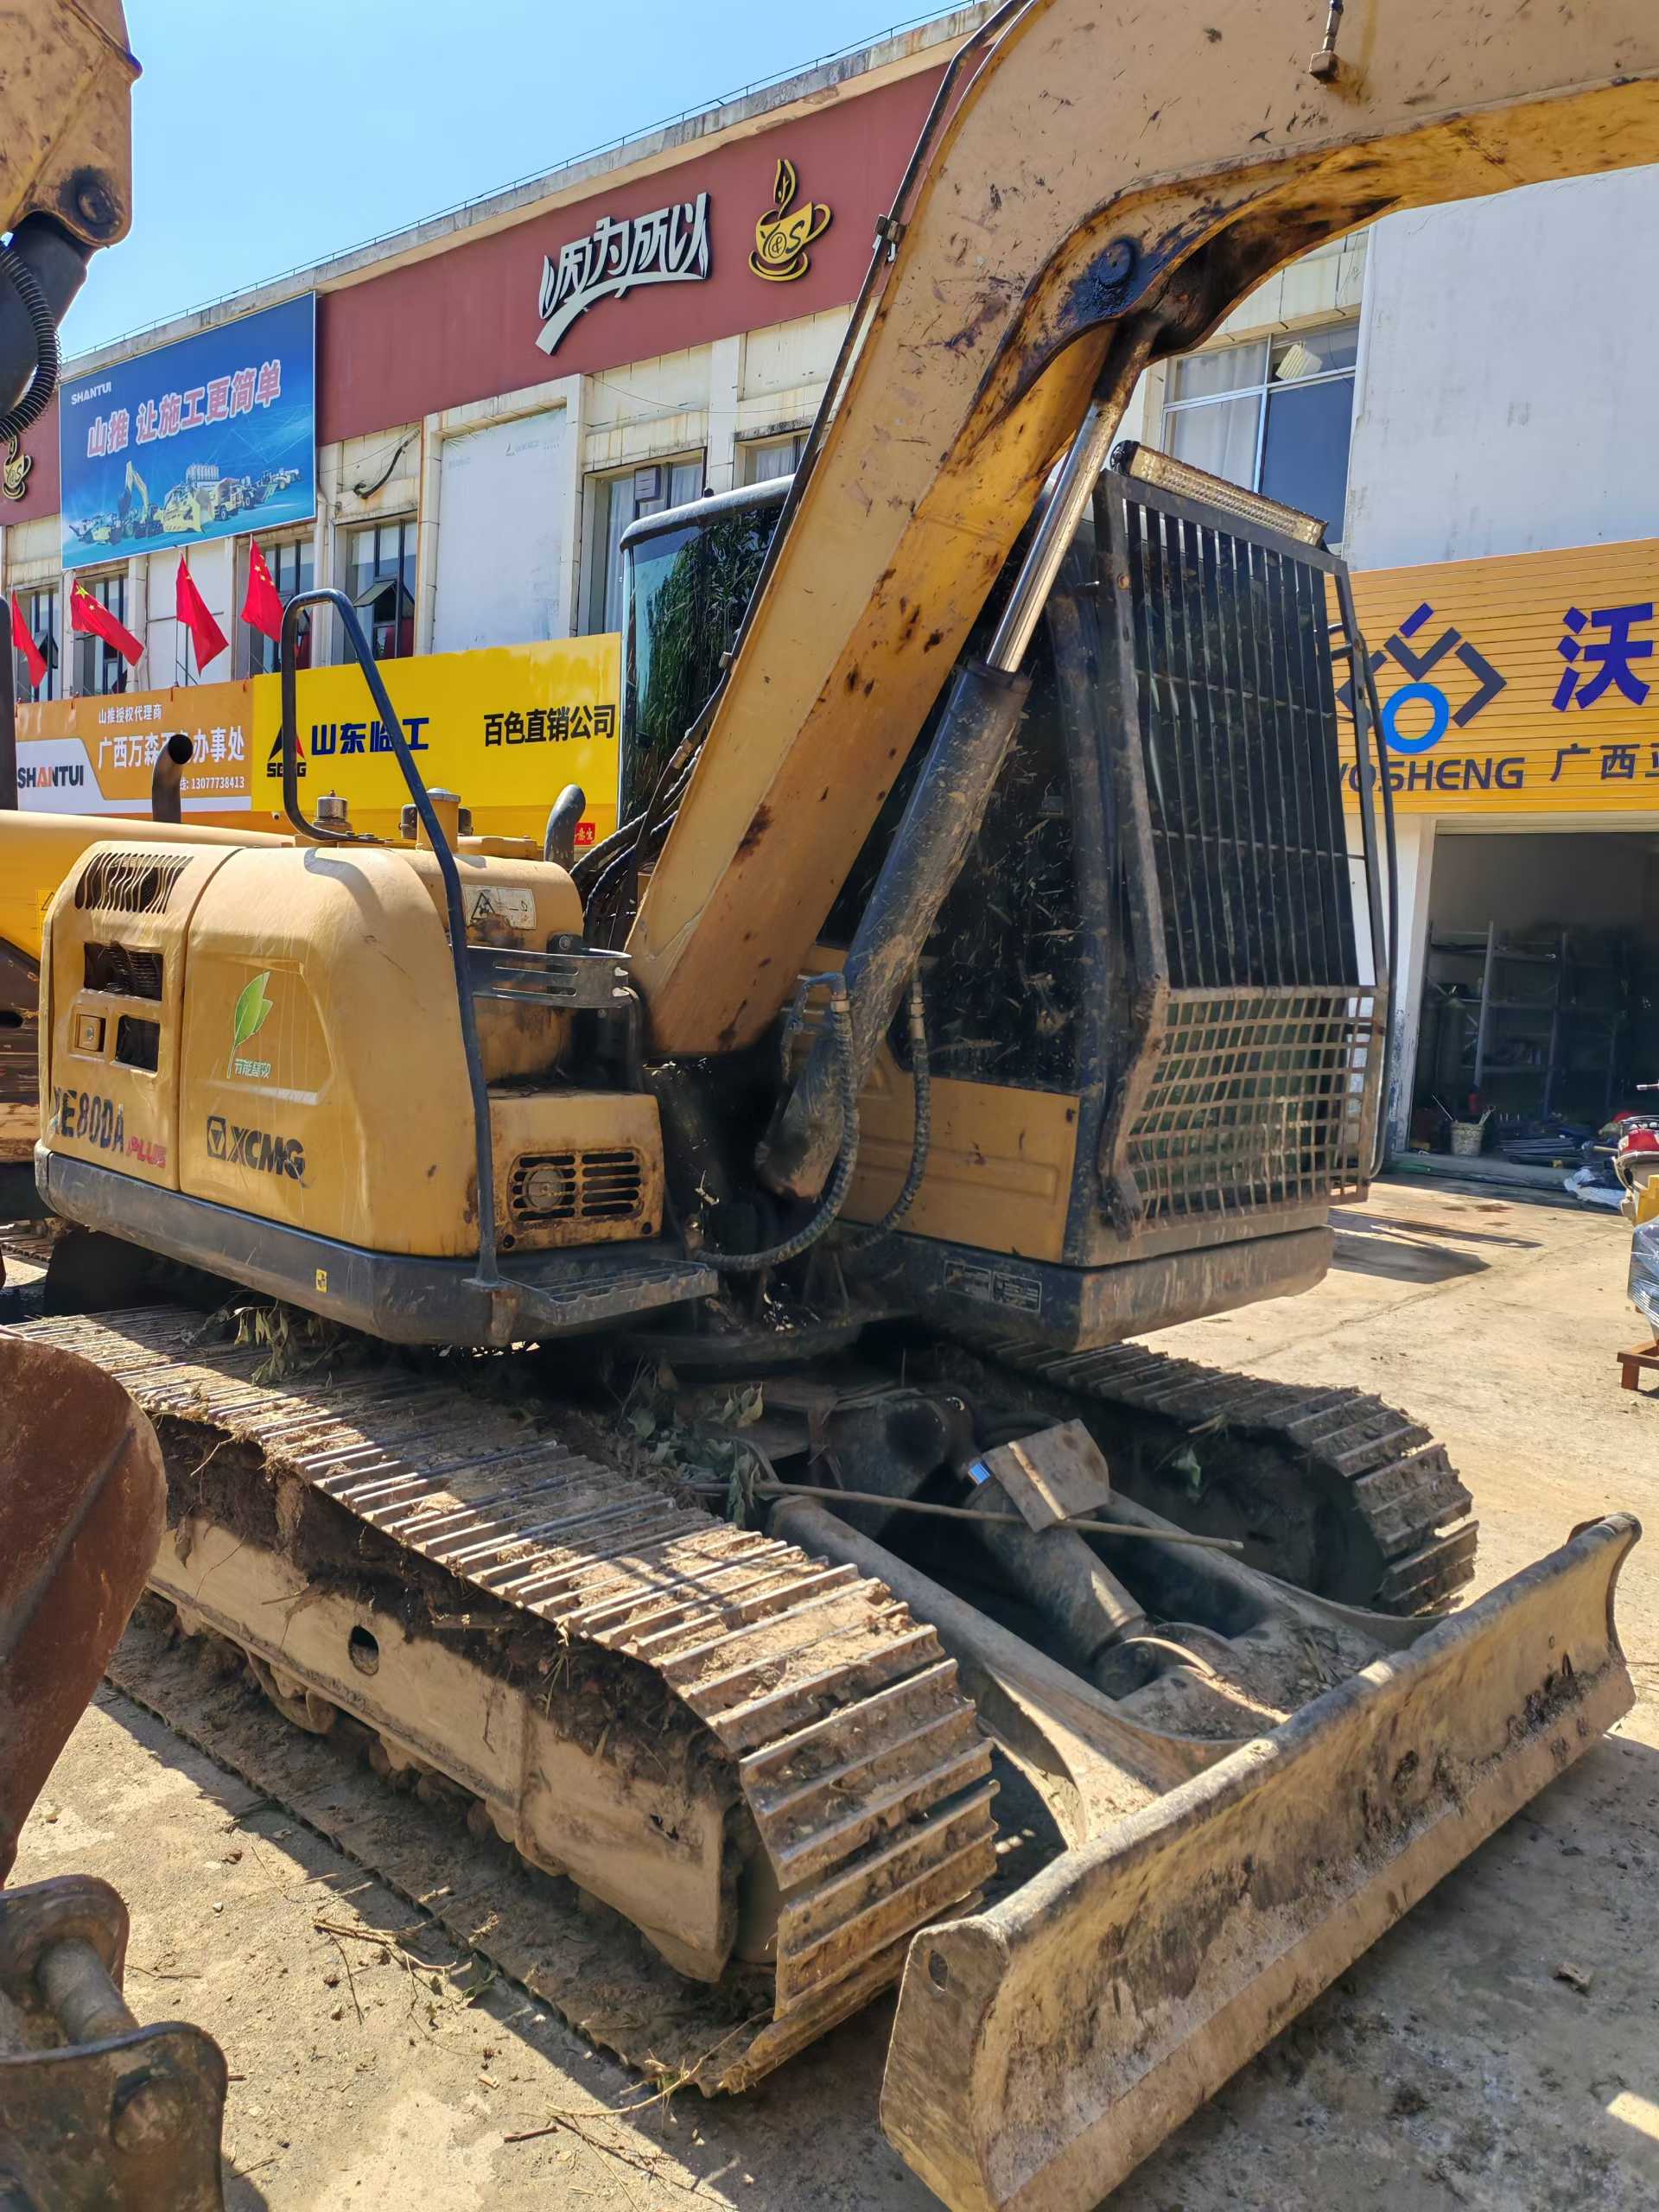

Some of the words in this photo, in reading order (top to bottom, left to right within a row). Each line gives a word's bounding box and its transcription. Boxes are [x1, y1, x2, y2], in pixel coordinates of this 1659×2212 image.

[71, 382, 111, 404] SHANTUI
[87, 408, 130, 458] 山推
[136, 359, 281, 445] 让施工更简单
[1552, 602, 1653, 711] 沃
[99, 704, 162, 724] 山推授权代理商
[484, 704, 615, 747] 百色直销公司
[98, 726, 245, 769] 广西万森办事处
[17, 765, 84, 788] SHANTUI
[191, 776, 245, 790] 13077738413
[266, 762, 307, 778] SDG
[226, 1126, 306, 1180] XCMG
